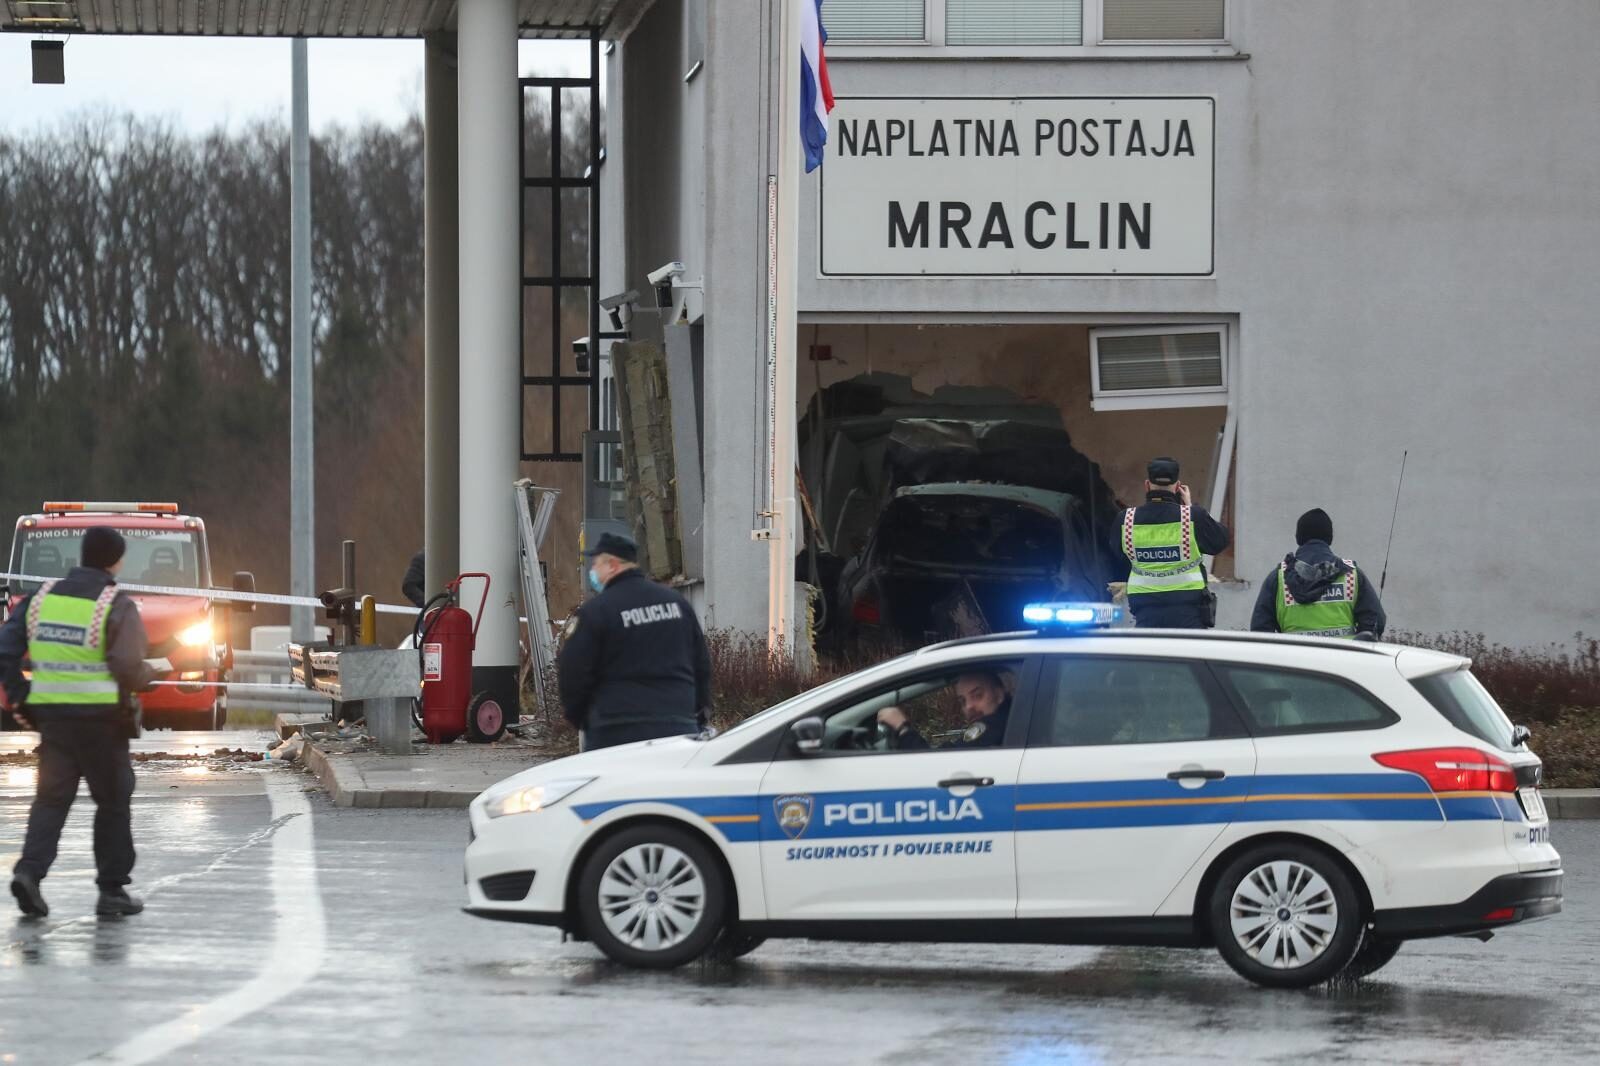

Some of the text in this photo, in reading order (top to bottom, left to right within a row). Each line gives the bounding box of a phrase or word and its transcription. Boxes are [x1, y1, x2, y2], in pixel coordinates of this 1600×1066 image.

[838, 118, 1195, 157] NAPLATNA POSTAJA
[887, 200, 1151, 250] MRACLIN
[1136, 549, 1179, 560] POLICIJA
[620, 602, 682, 628] POLICIJA
[823, 799, 983, 826] POLICIJA
[786, 840, 993, 861] SIGURNOST I POVJERENJE
